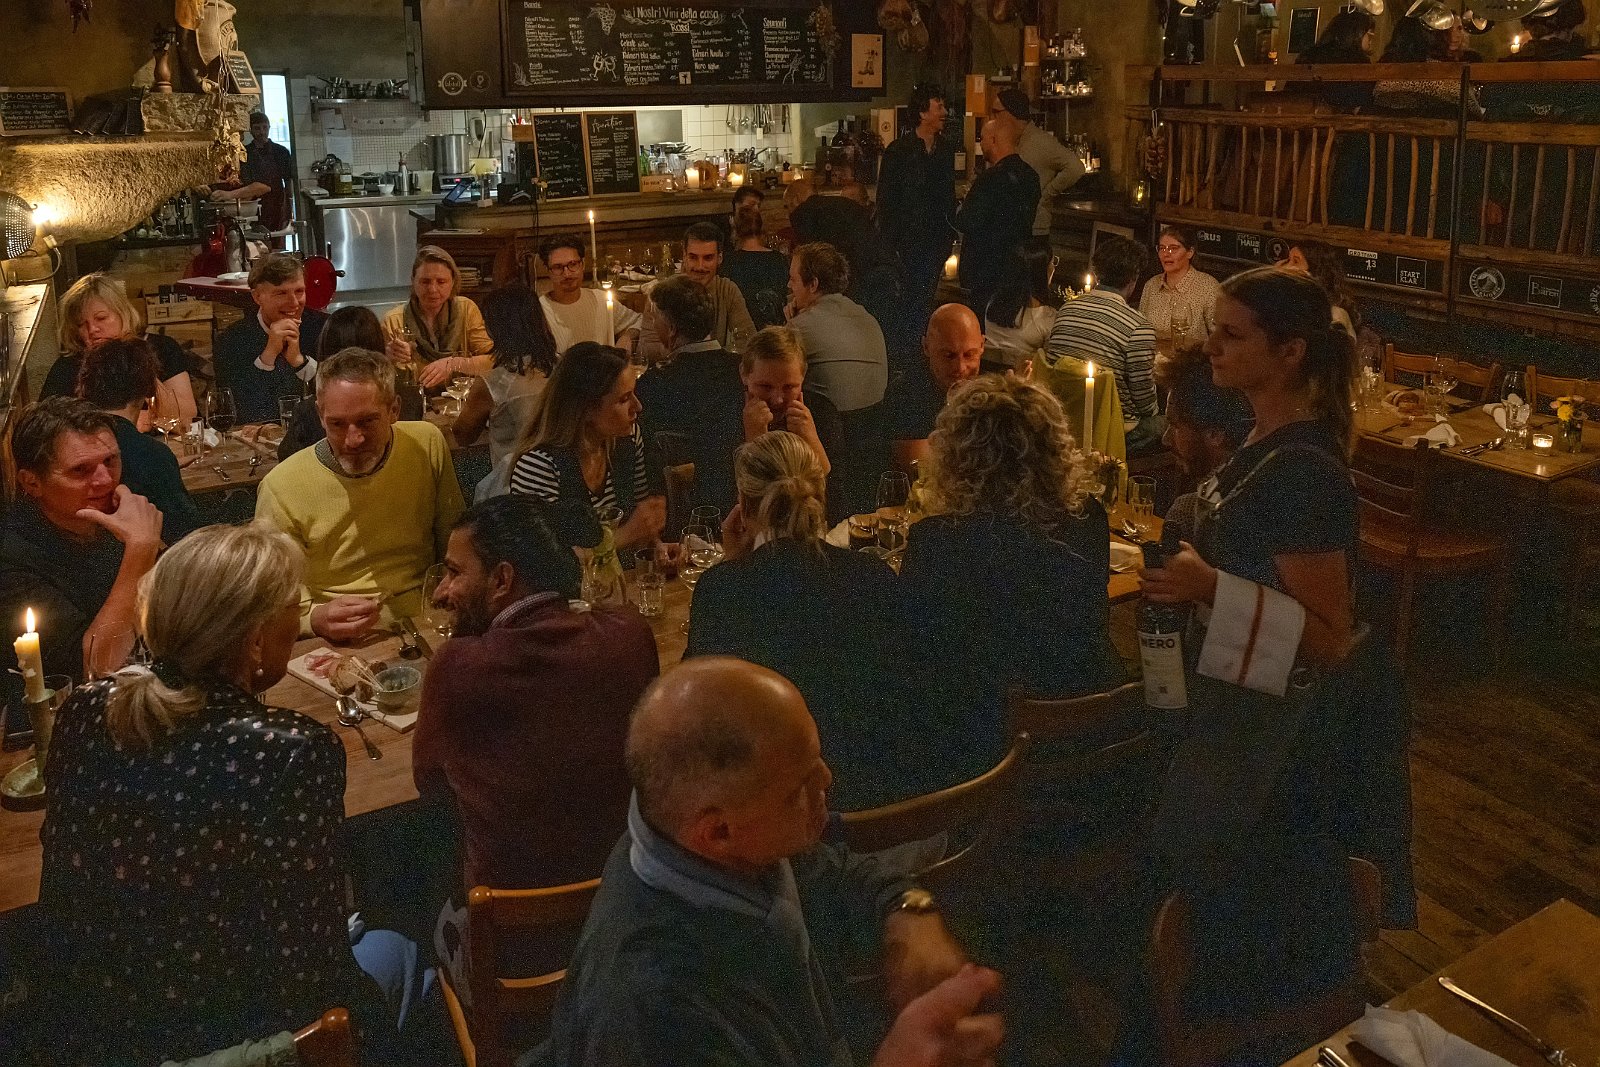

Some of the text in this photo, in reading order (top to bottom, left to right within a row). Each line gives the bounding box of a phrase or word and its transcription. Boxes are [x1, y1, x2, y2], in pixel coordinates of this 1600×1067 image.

[637, 7, 661, 18] Nostri
[662, 7, 678, 18] Vini
[680, 8, 698, 18] della
[699, 10, 719, 19] casa
[1400, 270, 1420, 279] START
[1400, 276, 1418, 285] KLAR
[1141, 638, 1175, 649] NERO
